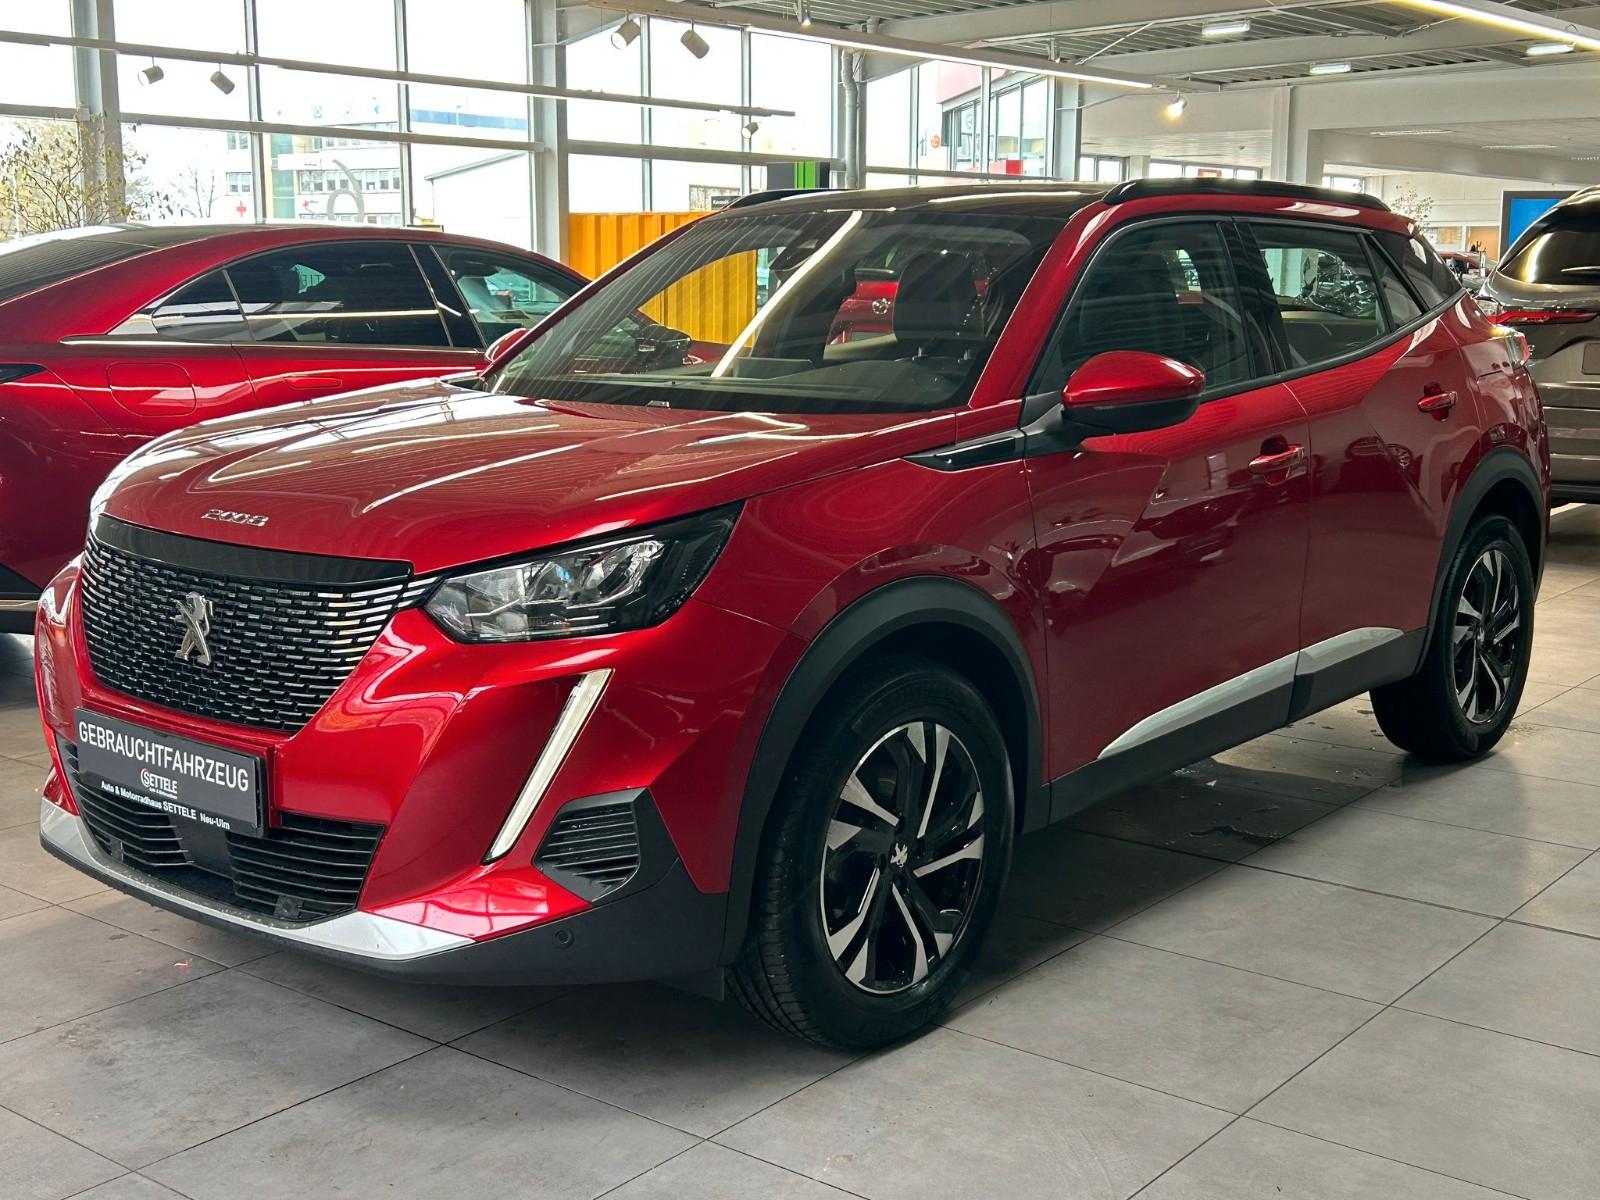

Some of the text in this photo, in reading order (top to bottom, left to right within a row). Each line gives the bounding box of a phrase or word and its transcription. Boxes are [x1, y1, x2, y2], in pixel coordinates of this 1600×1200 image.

[201, 508, 269, 527] 2008
[78, 721, 249, 792] GEBRAUCHTFAHRZEUG
[142, 770, 178, 794] SETTELE
[101, 780, 114, 793] Auto
[115, 785, 120, 795] &
[120, 787, 162, 809] Motorradhaus
[163, 801, 197, 820] SETTELE
[200, 812, 231, 830] Neu-Ulm
